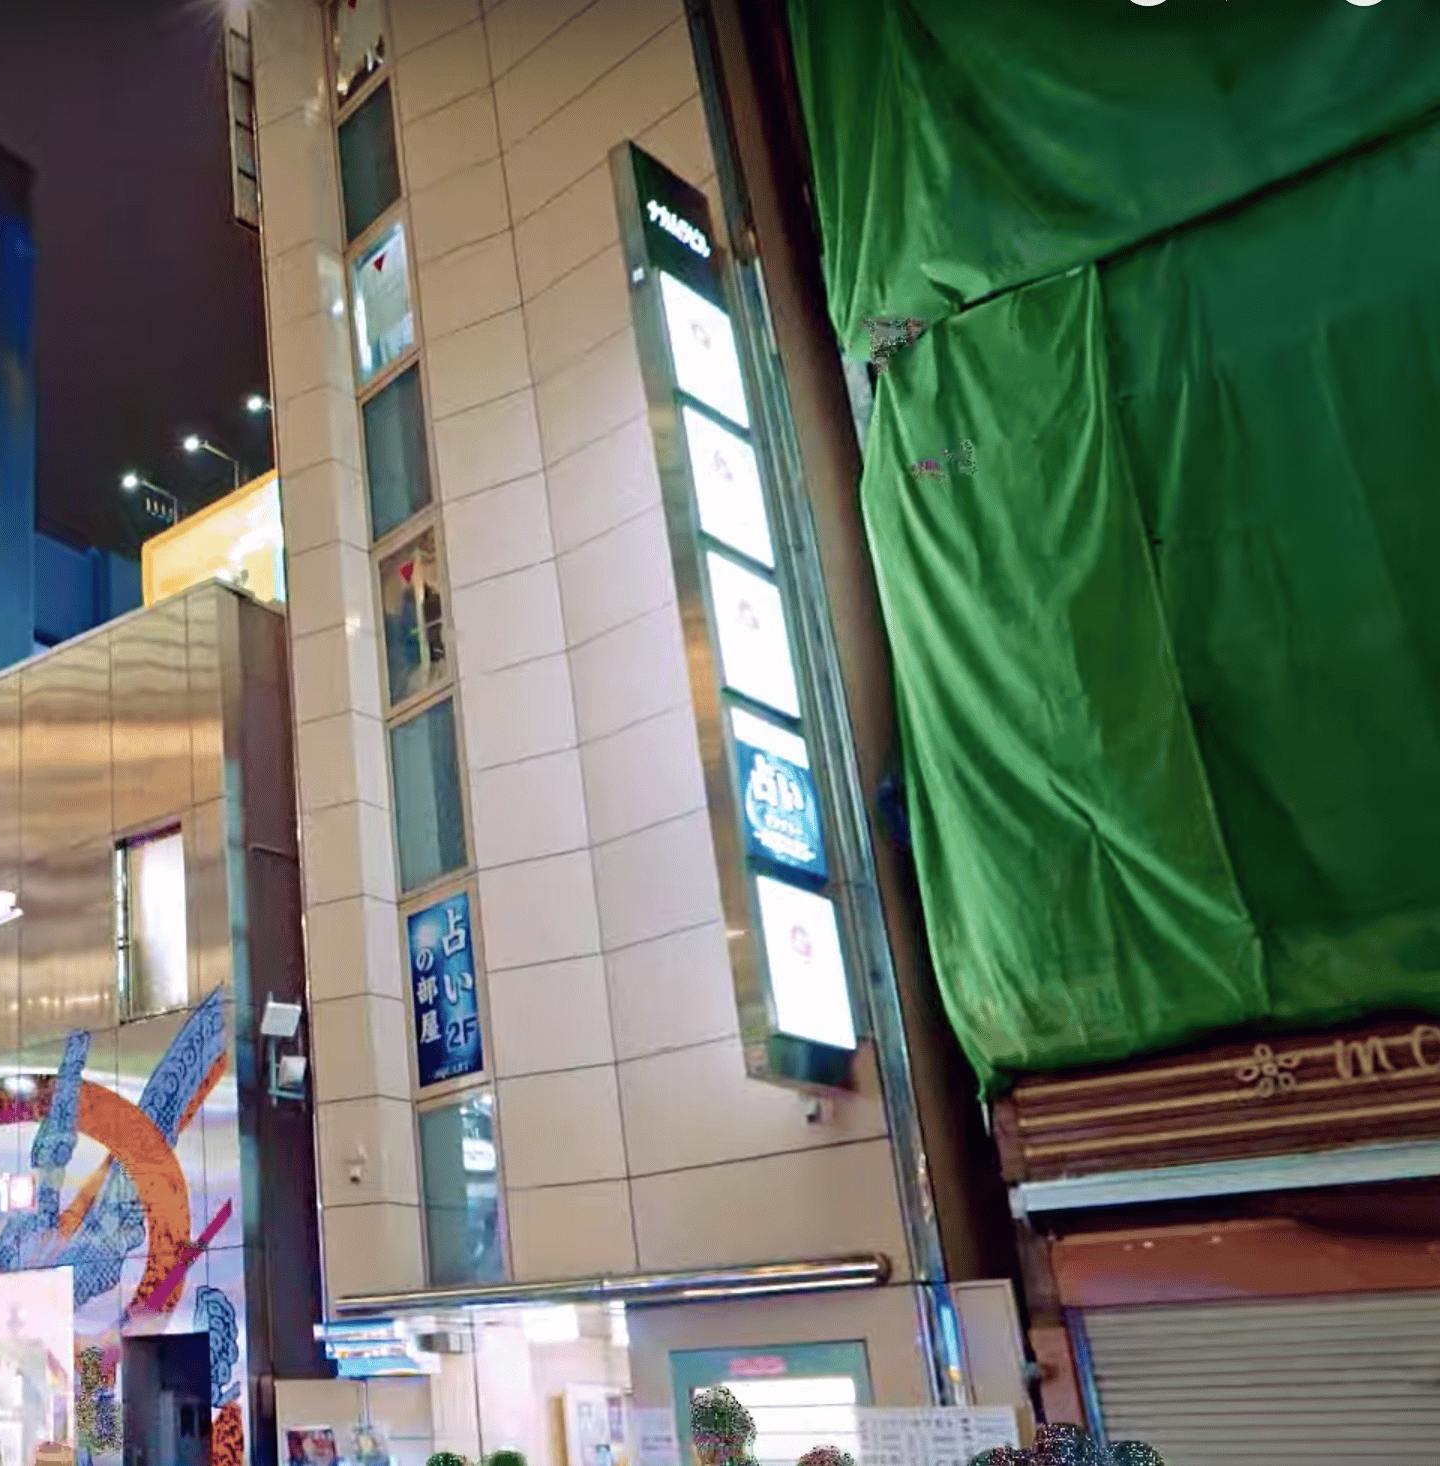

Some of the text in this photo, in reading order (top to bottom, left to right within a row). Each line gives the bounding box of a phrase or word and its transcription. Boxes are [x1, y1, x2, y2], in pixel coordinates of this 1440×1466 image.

[416, 947, 442, 1044] の部屋
[442, 908, 473, 1006] 占い
[447, 1015, 478, 1050] 2F
